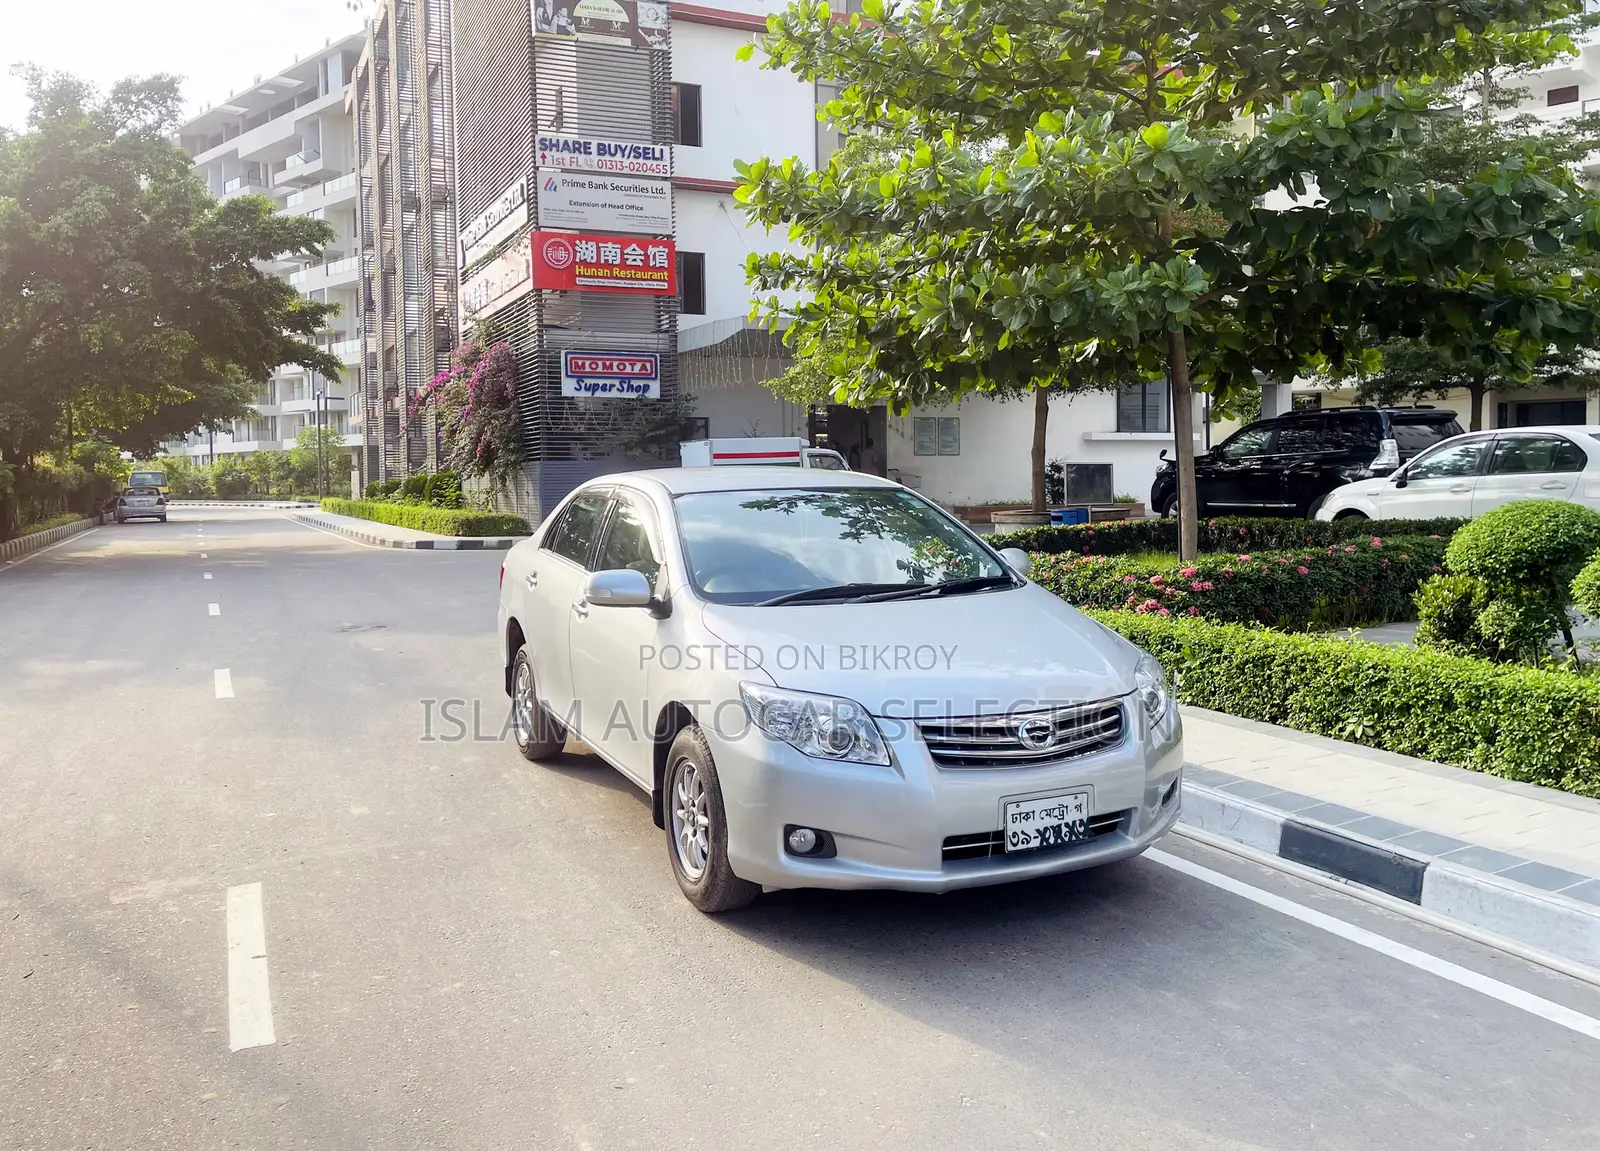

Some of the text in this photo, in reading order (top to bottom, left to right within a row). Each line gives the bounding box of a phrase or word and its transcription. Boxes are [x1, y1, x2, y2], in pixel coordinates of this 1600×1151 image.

[539, 137, 592, 156] SHARE
[551, 155, 668, 175] 1st Fl. 01313-020455
[561, 179, 666, 195] Prime Bank Securities Ltd.
[569, 200, 644, 211] Extension of Head Office
[575, 239, 668, 268] 湖南会馆
[575, 265, 668, 280] Hunan Restaurant
[574, 361, 649, 372] MOMOTA
[1011, 803, 1082, 824] ঢাকা মেট্রো গ
